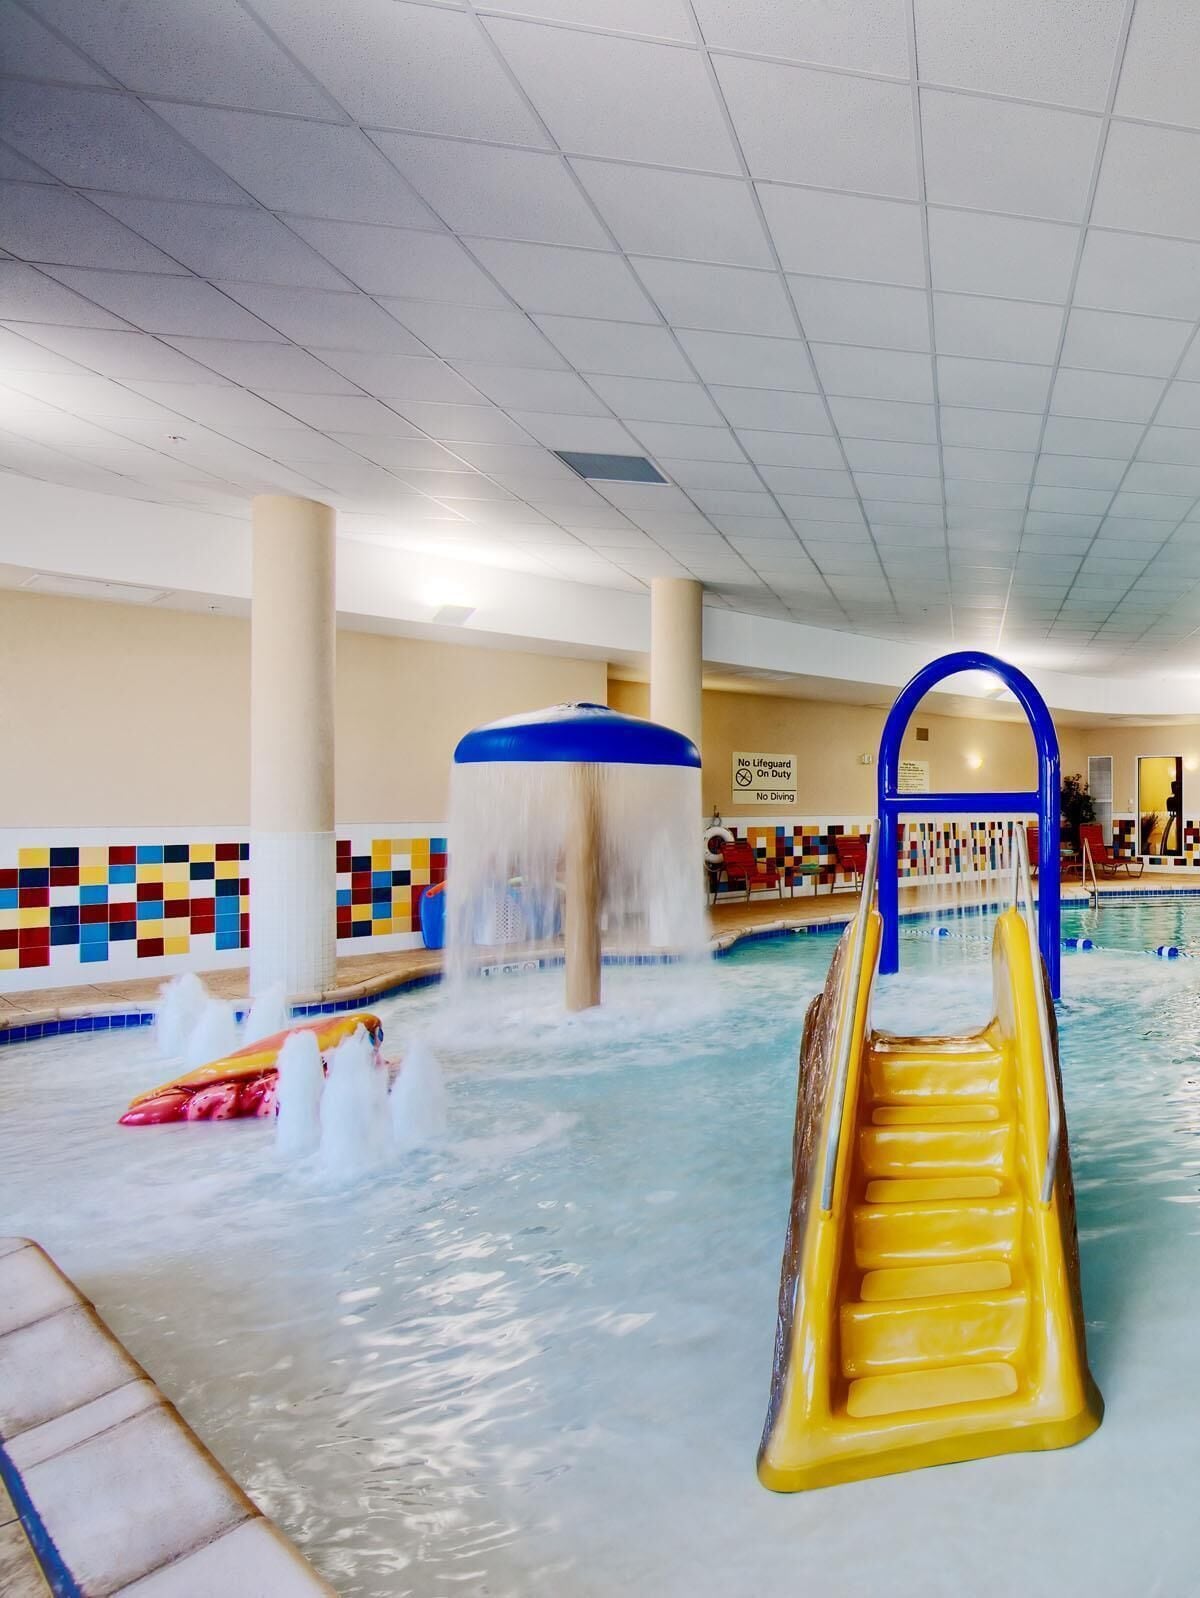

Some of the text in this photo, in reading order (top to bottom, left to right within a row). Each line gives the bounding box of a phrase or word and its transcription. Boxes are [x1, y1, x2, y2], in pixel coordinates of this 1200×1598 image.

[738, 758, 791, 769] No Lifeguard
[757, 769, 791, 780] On Duty
[756, 792, 795, 802] No Diving
